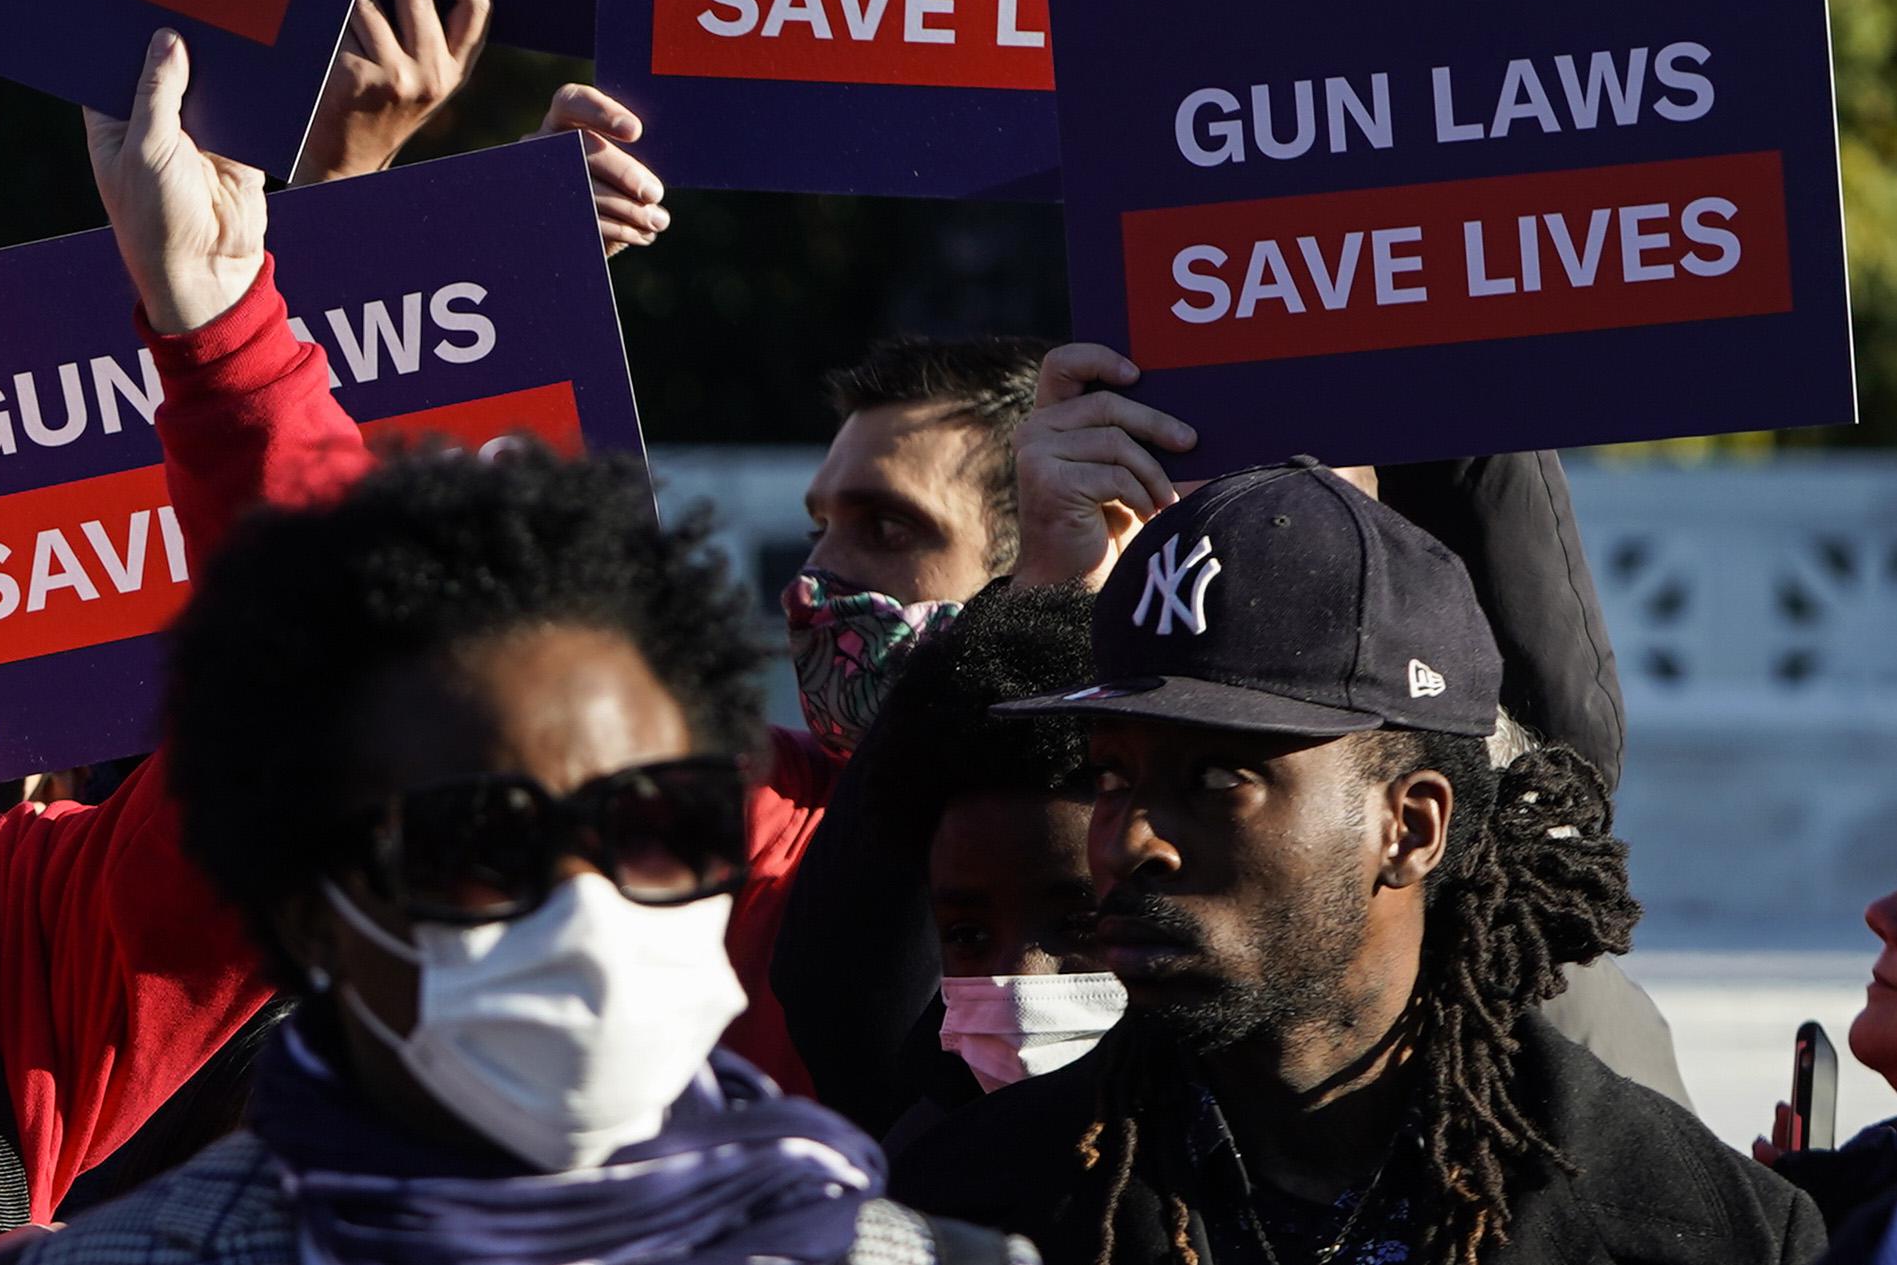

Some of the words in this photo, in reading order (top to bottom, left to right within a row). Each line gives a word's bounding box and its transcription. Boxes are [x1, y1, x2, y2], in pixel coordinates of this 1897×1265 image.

[1174, 70, 1394, 167] GUN
[1431, 41, 1715, 143] LAWS
[1170, 226, 1428, 324] SAVE
[1463, 196, 1742, 297] LIVES
[1132, 533, 1222, 635] NY
